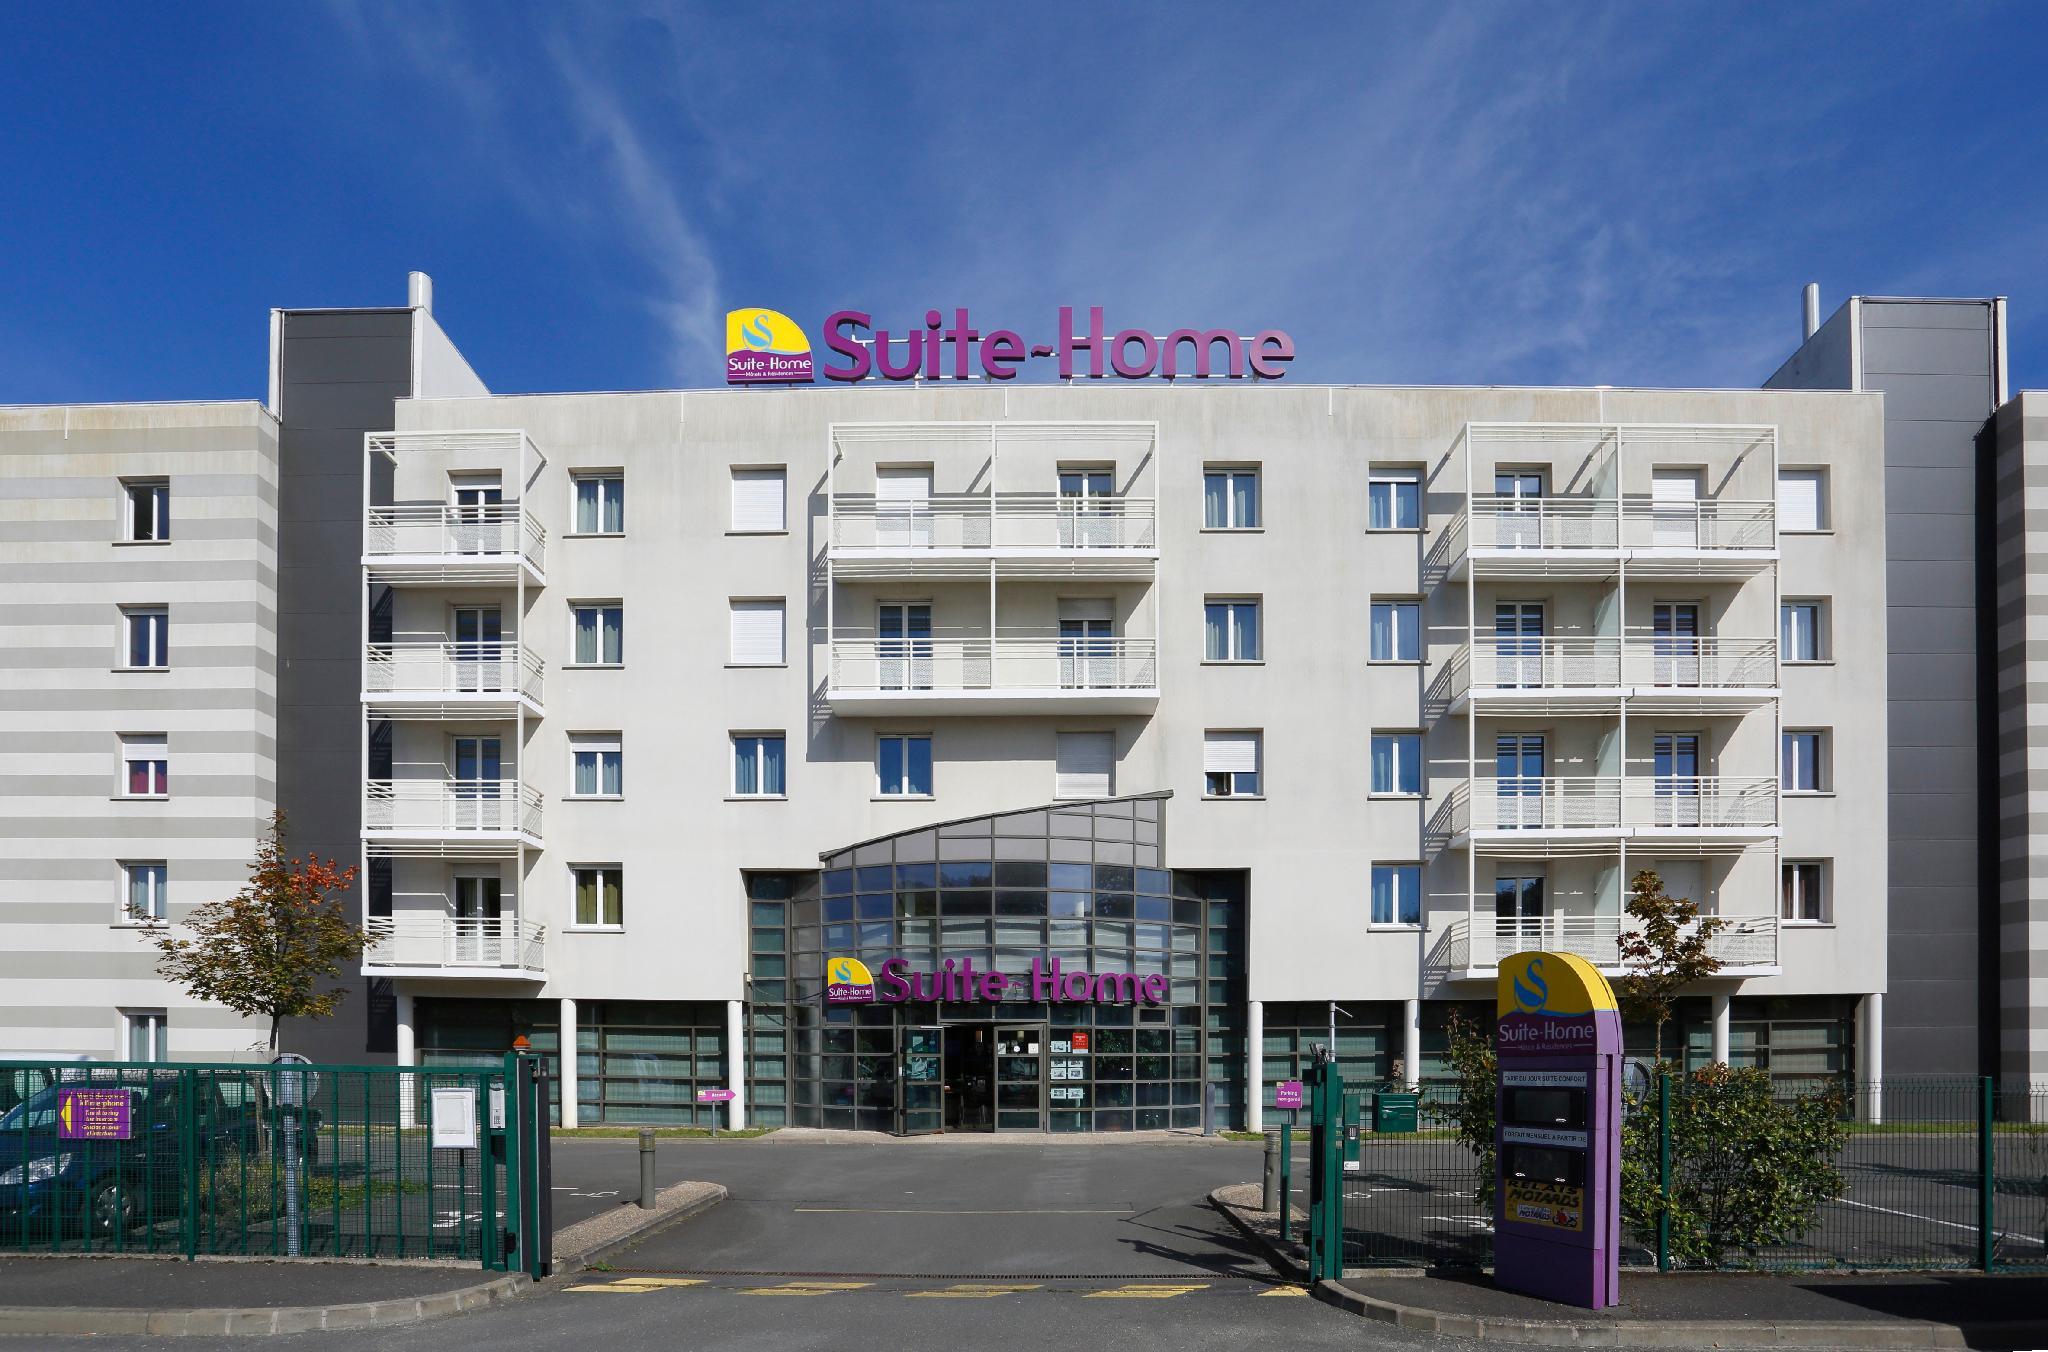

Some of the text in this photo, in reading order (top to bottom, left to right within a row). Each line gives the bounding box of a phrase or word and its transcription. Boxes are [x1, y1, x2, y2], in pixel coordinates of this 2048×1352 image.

[822, 306, 1294, 381] Suite-Home
[728, 357, 812, 371] Suite-Home
[881, 957, 1168, 1003] Suite-Home
[1499, 1021, 1594, 1042] Suite-Home
[1507, 1181, 1577, 1194] RELAIS
[1510, 1189, 1578, 1207] MOTARDS
